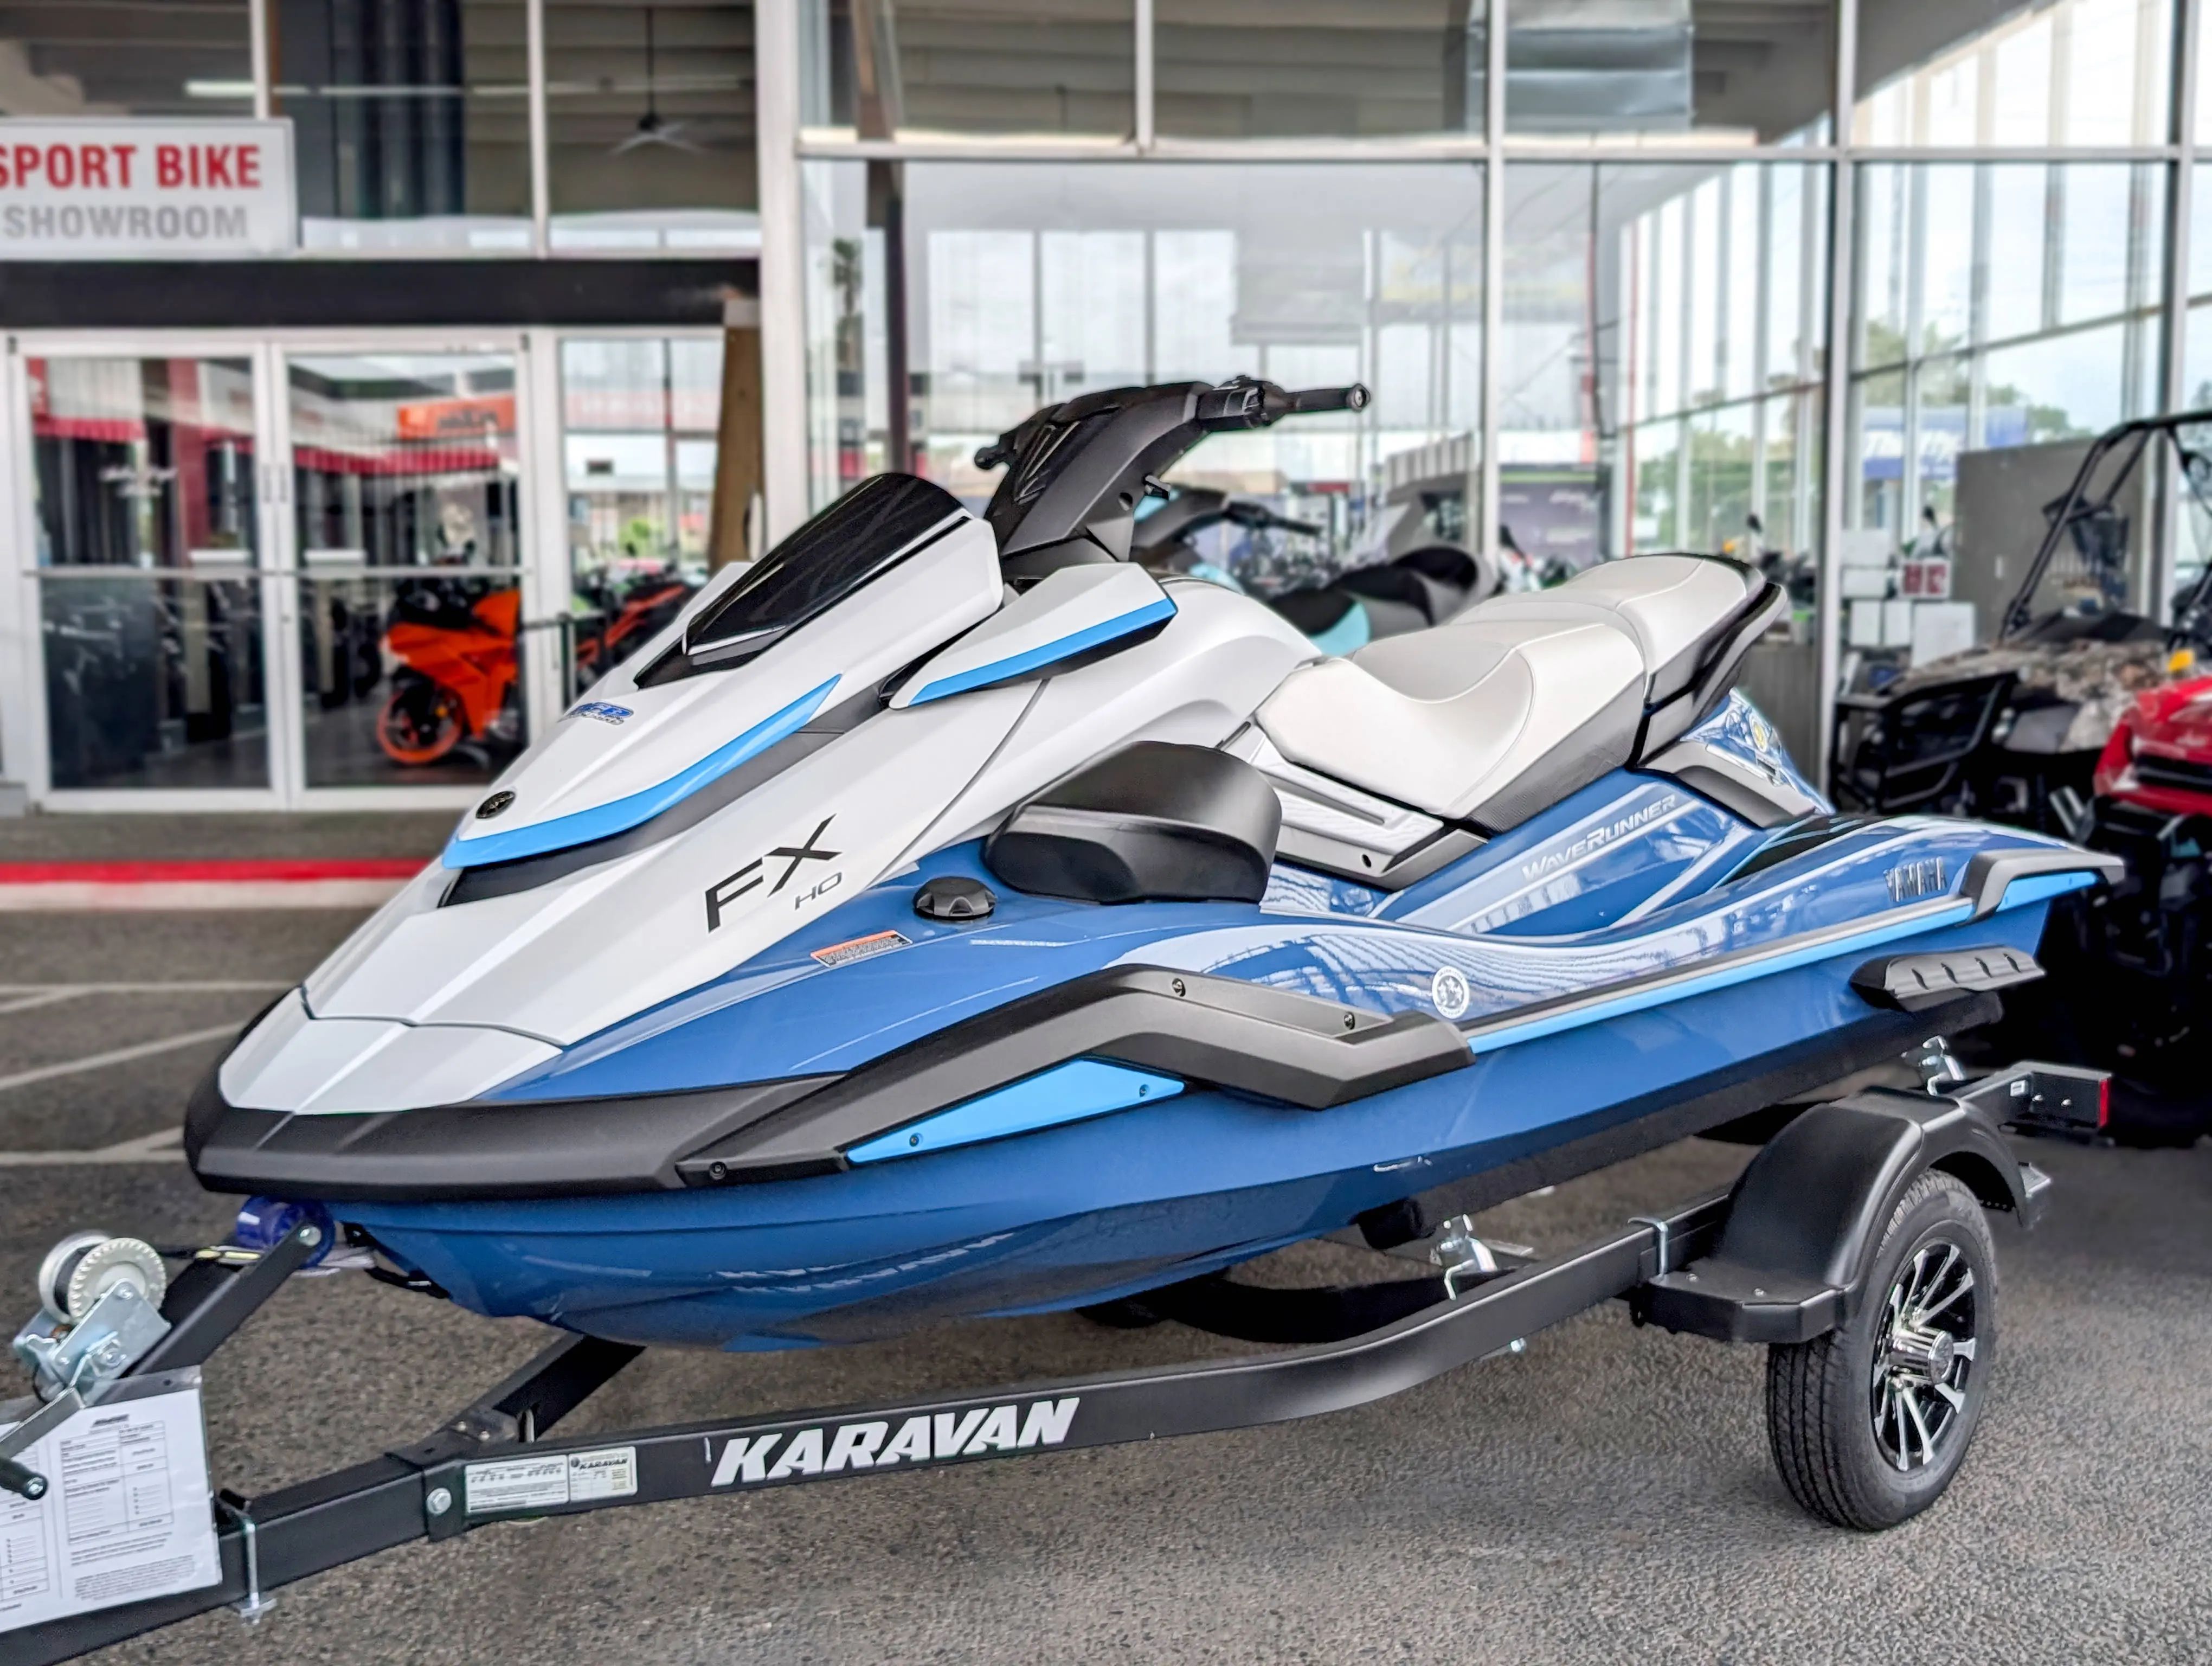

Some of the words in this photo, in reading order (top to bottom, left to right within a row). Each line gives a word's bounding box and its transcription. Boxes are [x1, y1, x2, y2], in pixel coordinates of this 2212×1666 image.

[156, 143, 262, 190] BIKE
[4, 204, 248, 239] SHOWROOM
[704, 813, 843, 933] FX
[794, 872, 843, 911] HO
[1883, 856, 1947, 902] YAMAHA
[711, 1397, 1080, 1487] KARAVAN
